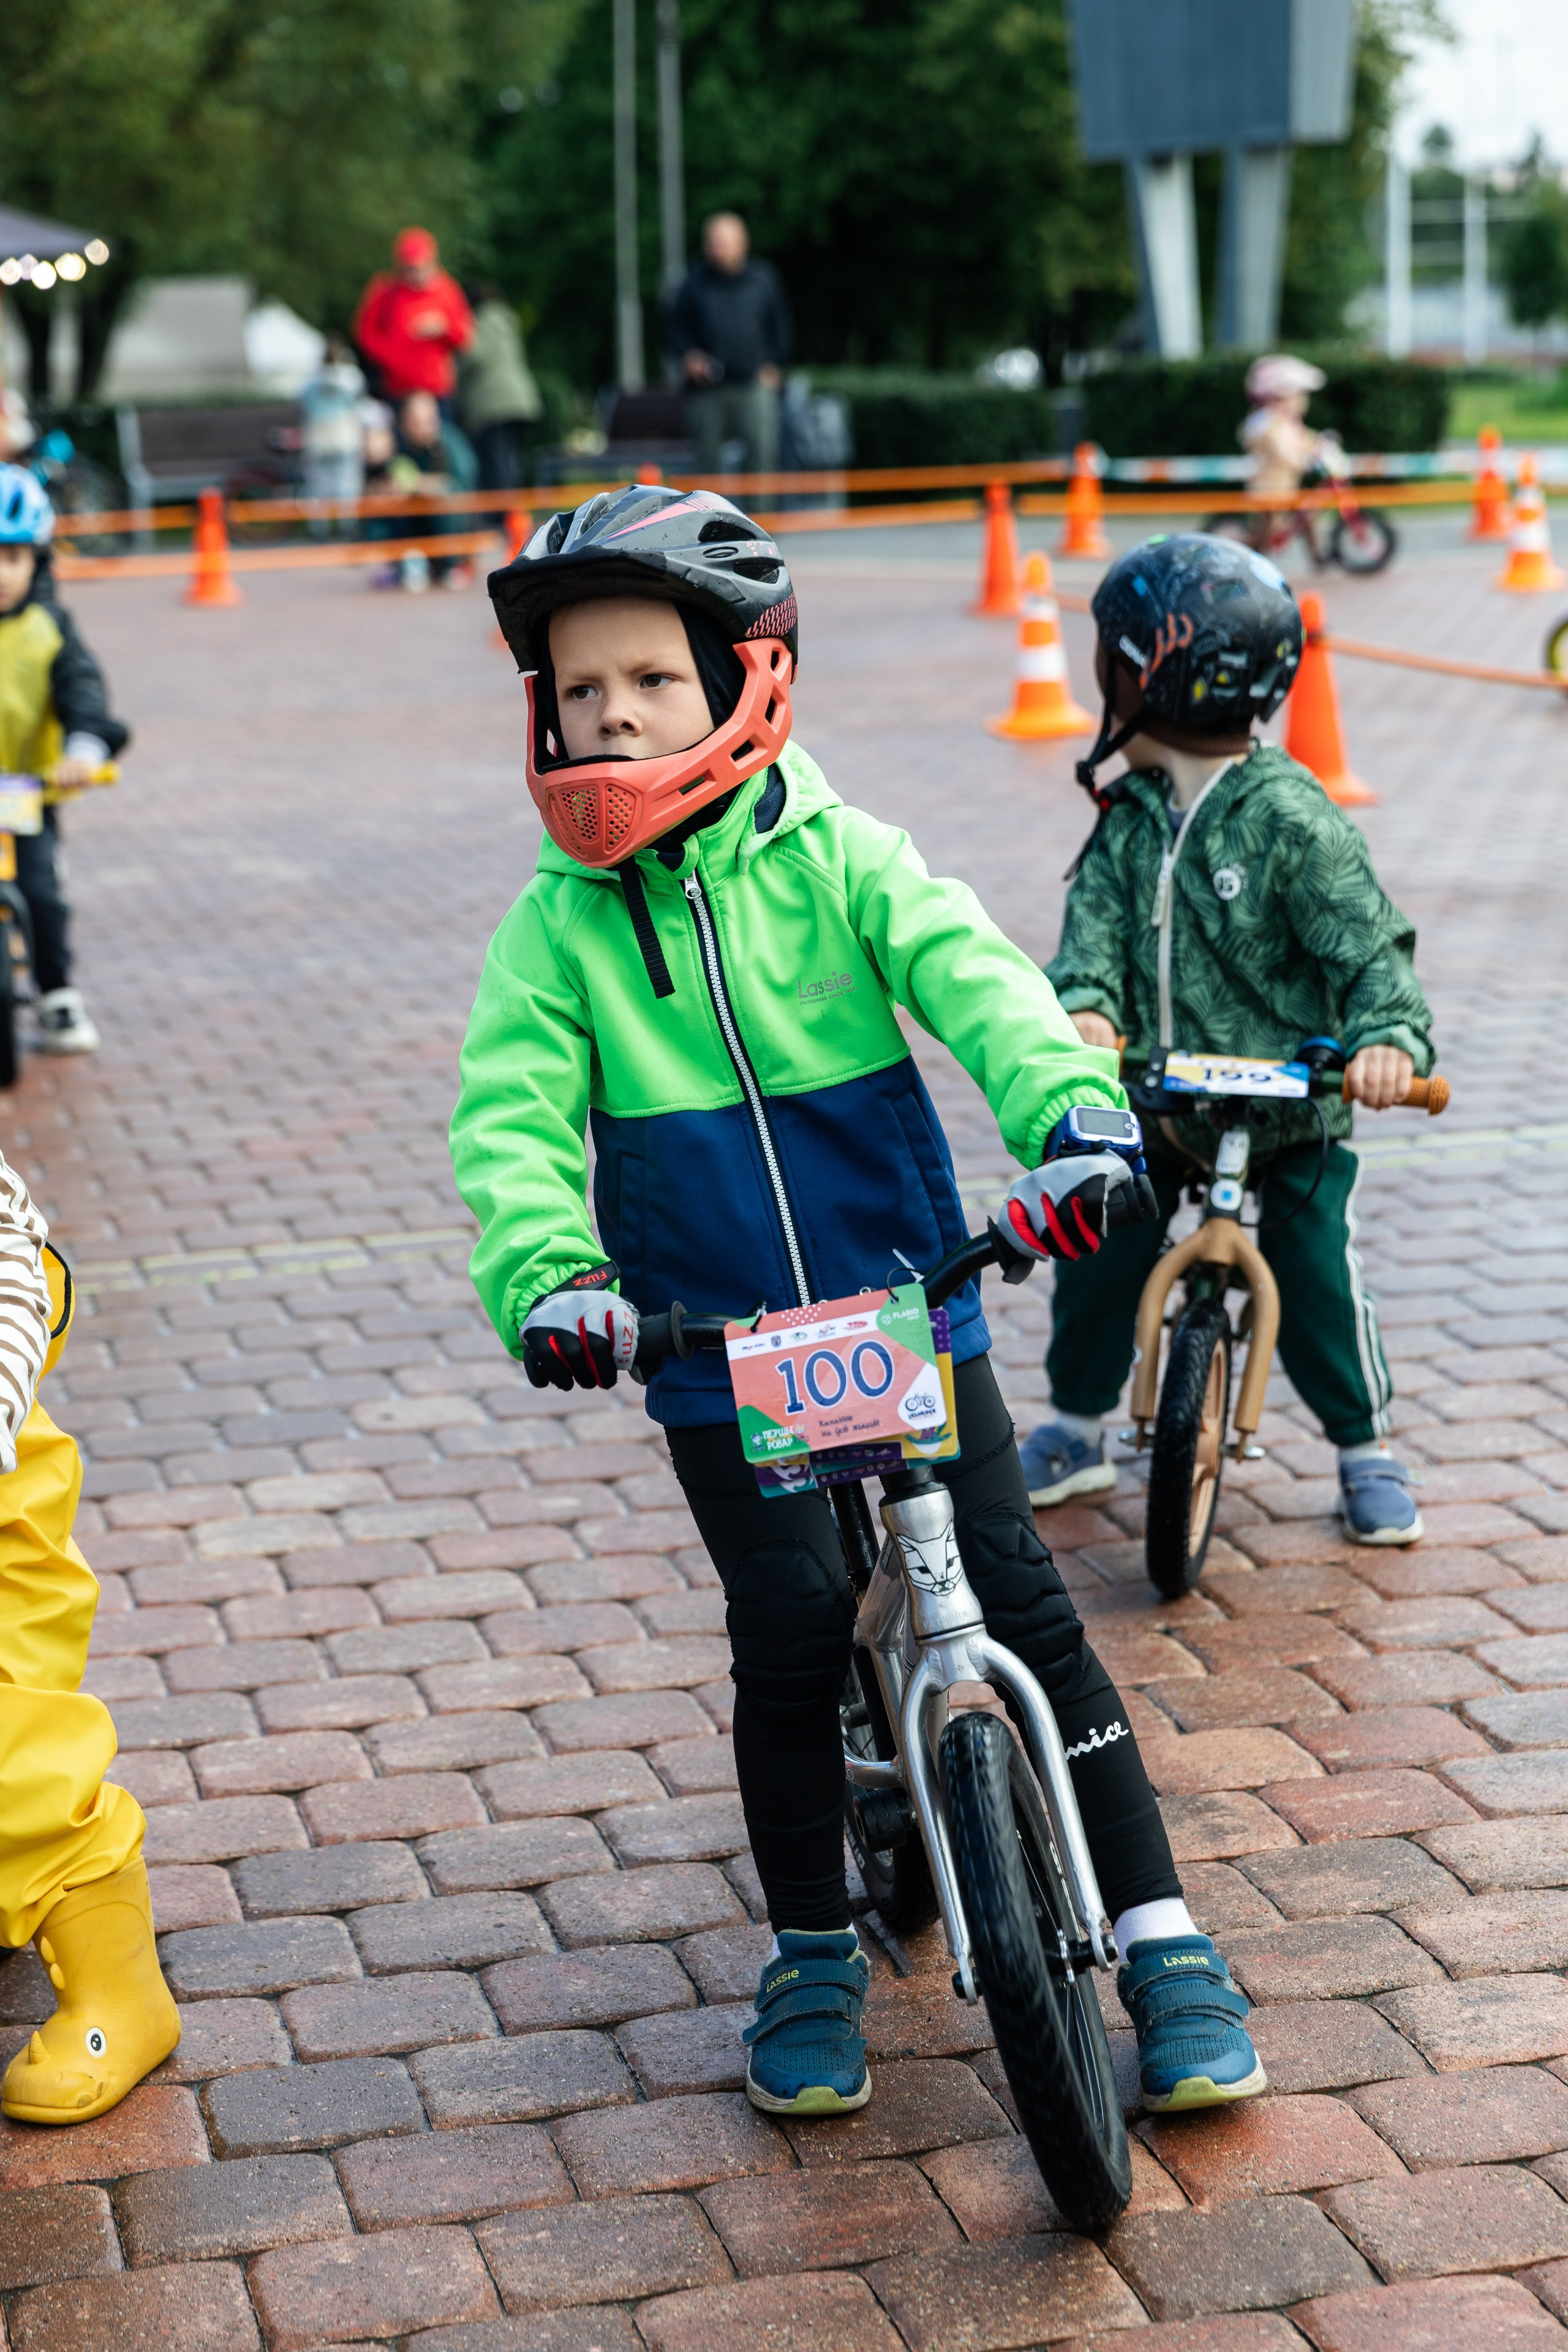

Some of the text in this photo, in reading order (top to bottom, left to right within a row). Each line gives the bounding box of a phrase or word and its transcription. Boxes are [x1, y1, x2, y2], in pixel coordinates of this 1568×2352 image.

[797, 971, 853, 998] Lassie
[799, 996, 827, 1005] OUTERWEAR
[829, 991, 843, 1000] SINCE
[775, 1340, 894, 1415] 100
[767, 1437, 794, 1451] РОВАР
